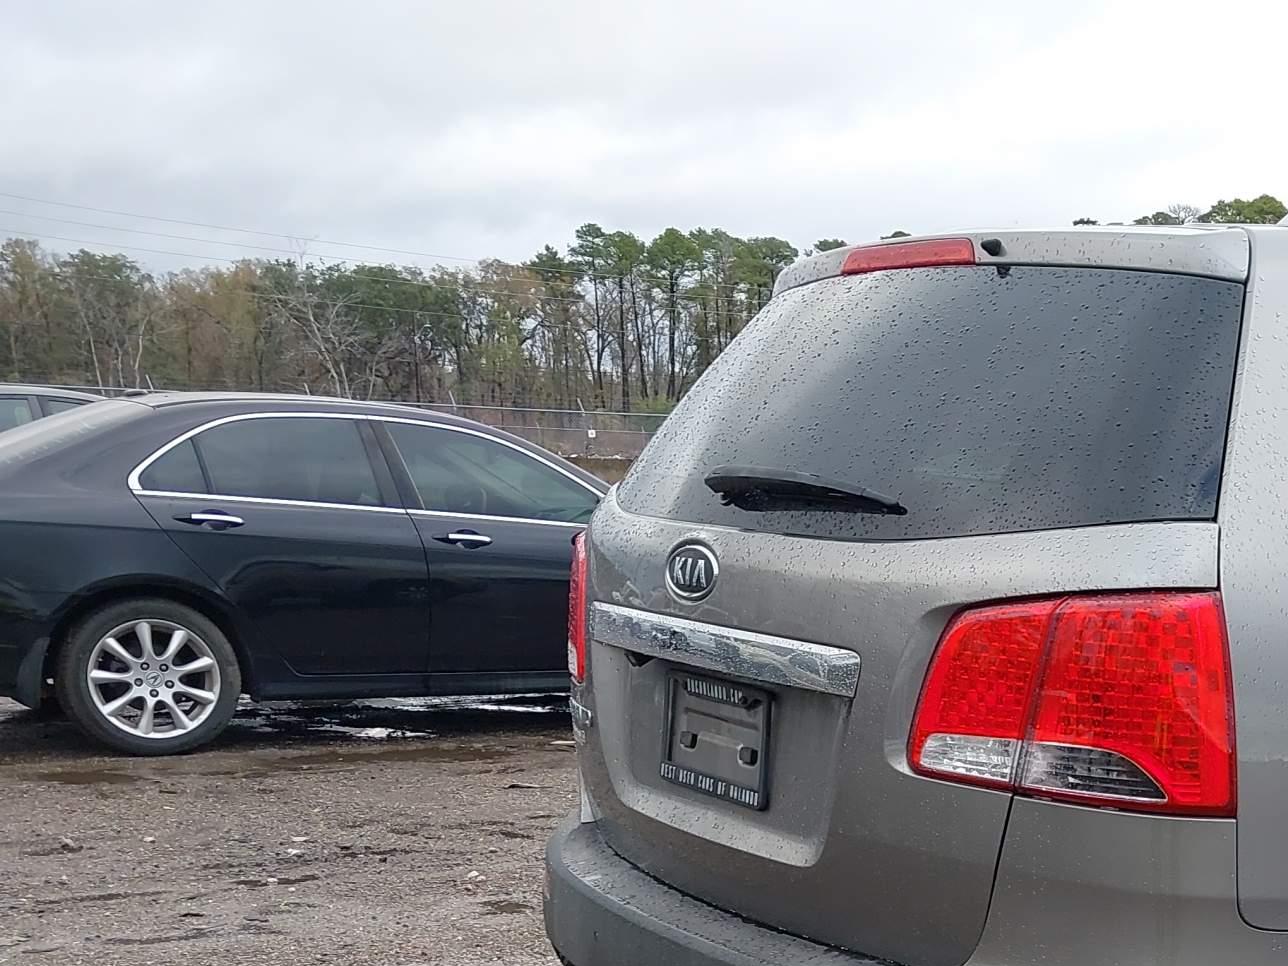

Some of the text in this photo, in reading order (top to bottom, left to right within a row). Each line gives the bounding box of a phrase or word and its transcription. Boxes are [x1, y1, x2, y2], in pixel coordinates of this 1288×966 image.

[673, 556, 706, 588] KIA
[660, 762, 759, 807] BEST USED CARS OF ORLANDO
